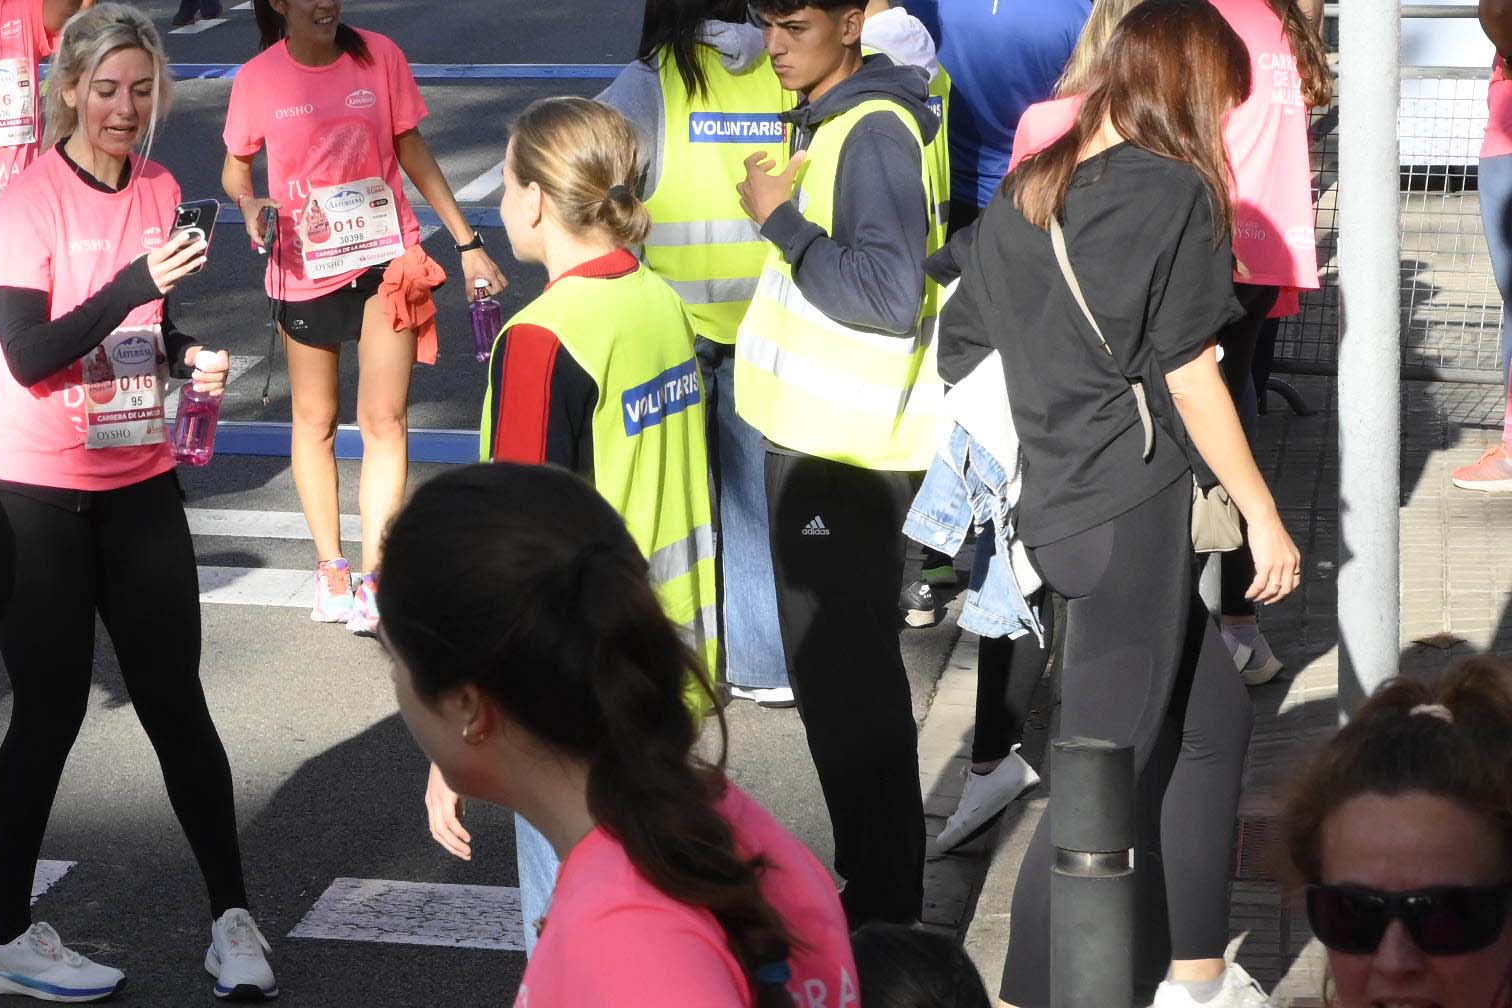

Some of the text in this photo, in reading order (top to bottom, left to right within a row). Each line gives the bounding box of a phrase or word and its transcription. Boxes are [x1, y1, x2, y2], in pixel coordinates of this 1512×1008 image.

[275, 103, 314, 120] OYSHO
[691, 118, 783, 137] VOLUNTARIS
[288, 178, 312, 201] TU
[333, 215, 366, 233] 016
[339, 232, 365, 245] 30398
[120, 372, 153, 392] 016
[131, 395, 143, 407] 95
[97, 413, 127, 423] CARRERA
[128, 411, 137, 419] DE
[96, 429, 131, 441] OYSHO
[801, 526, 830, 537] adidas
